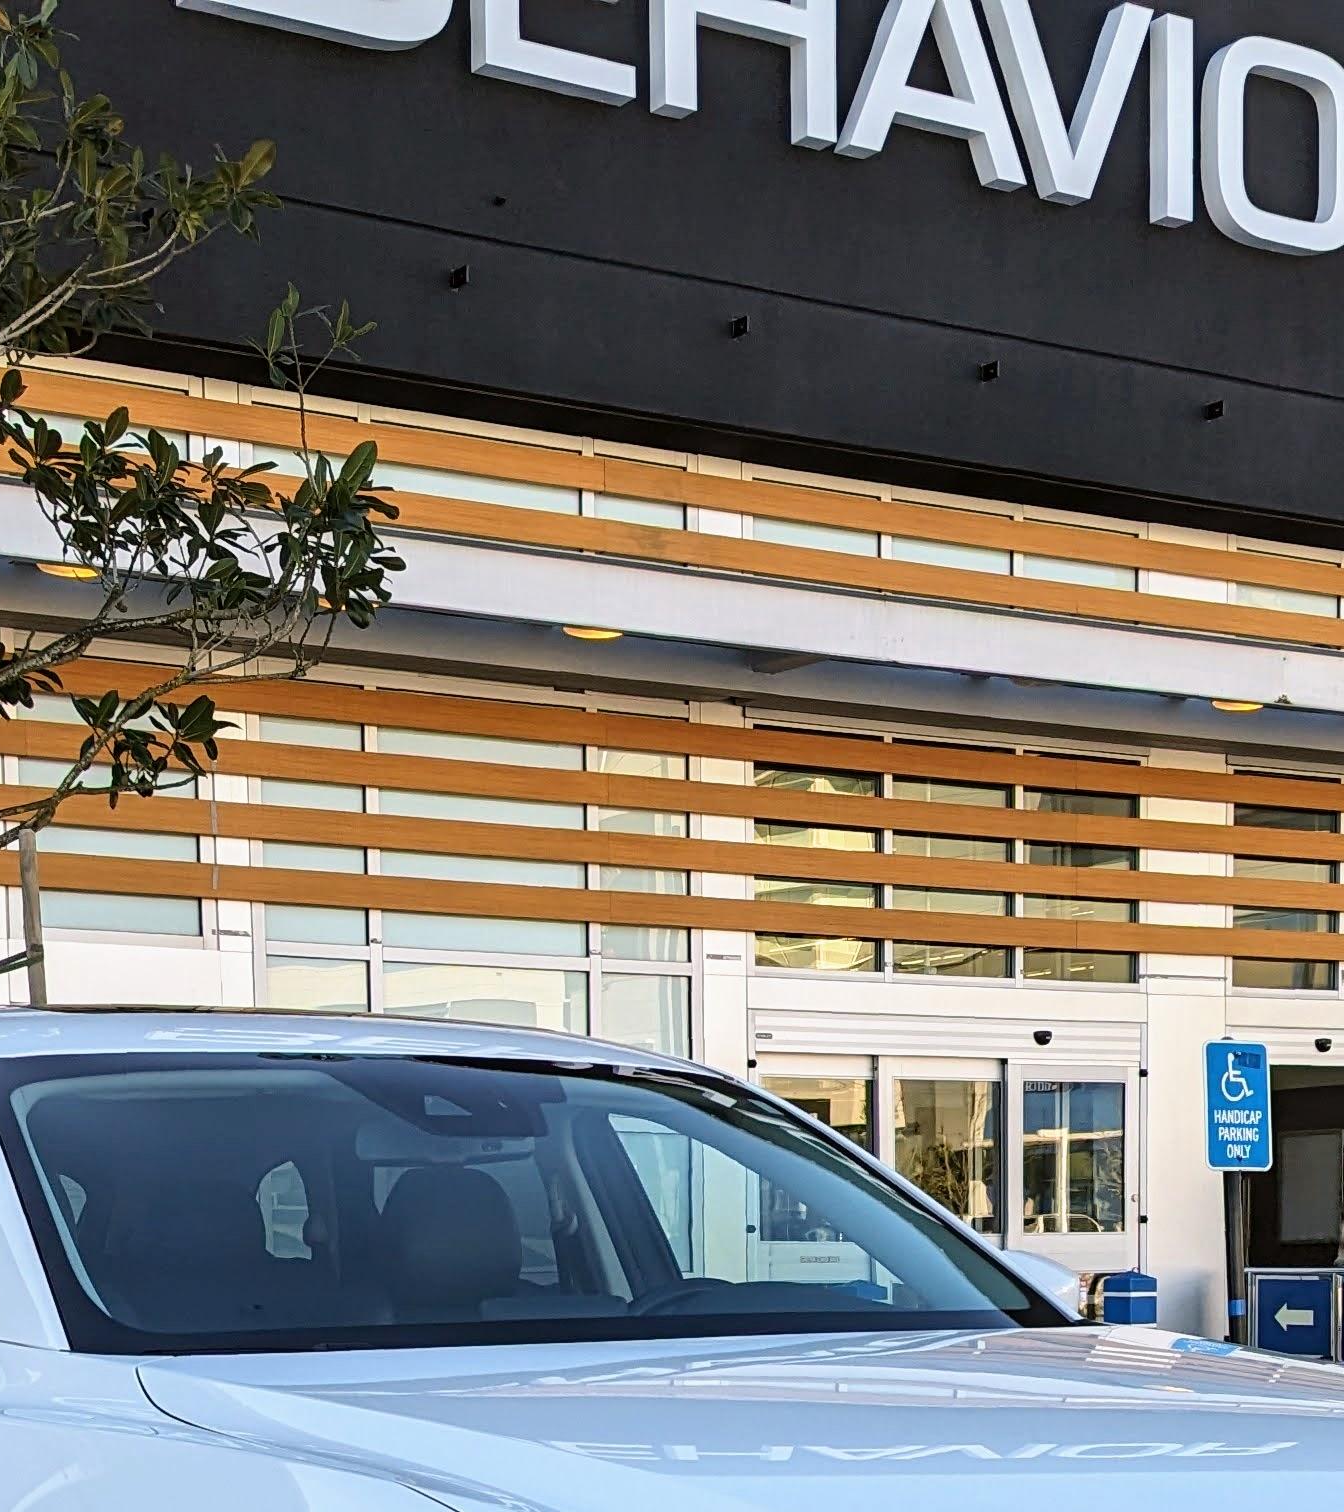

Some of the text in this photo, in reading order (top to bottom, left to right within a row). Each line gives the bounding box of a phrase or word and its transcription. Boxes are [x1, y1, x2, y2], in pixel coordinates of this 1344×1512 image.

[1213, 1109, 1263, 1125] HANDICAP
[1218, 1126, 1260, 1142] PARKING
[1226, 1143, 1252, 1159] ONLY
